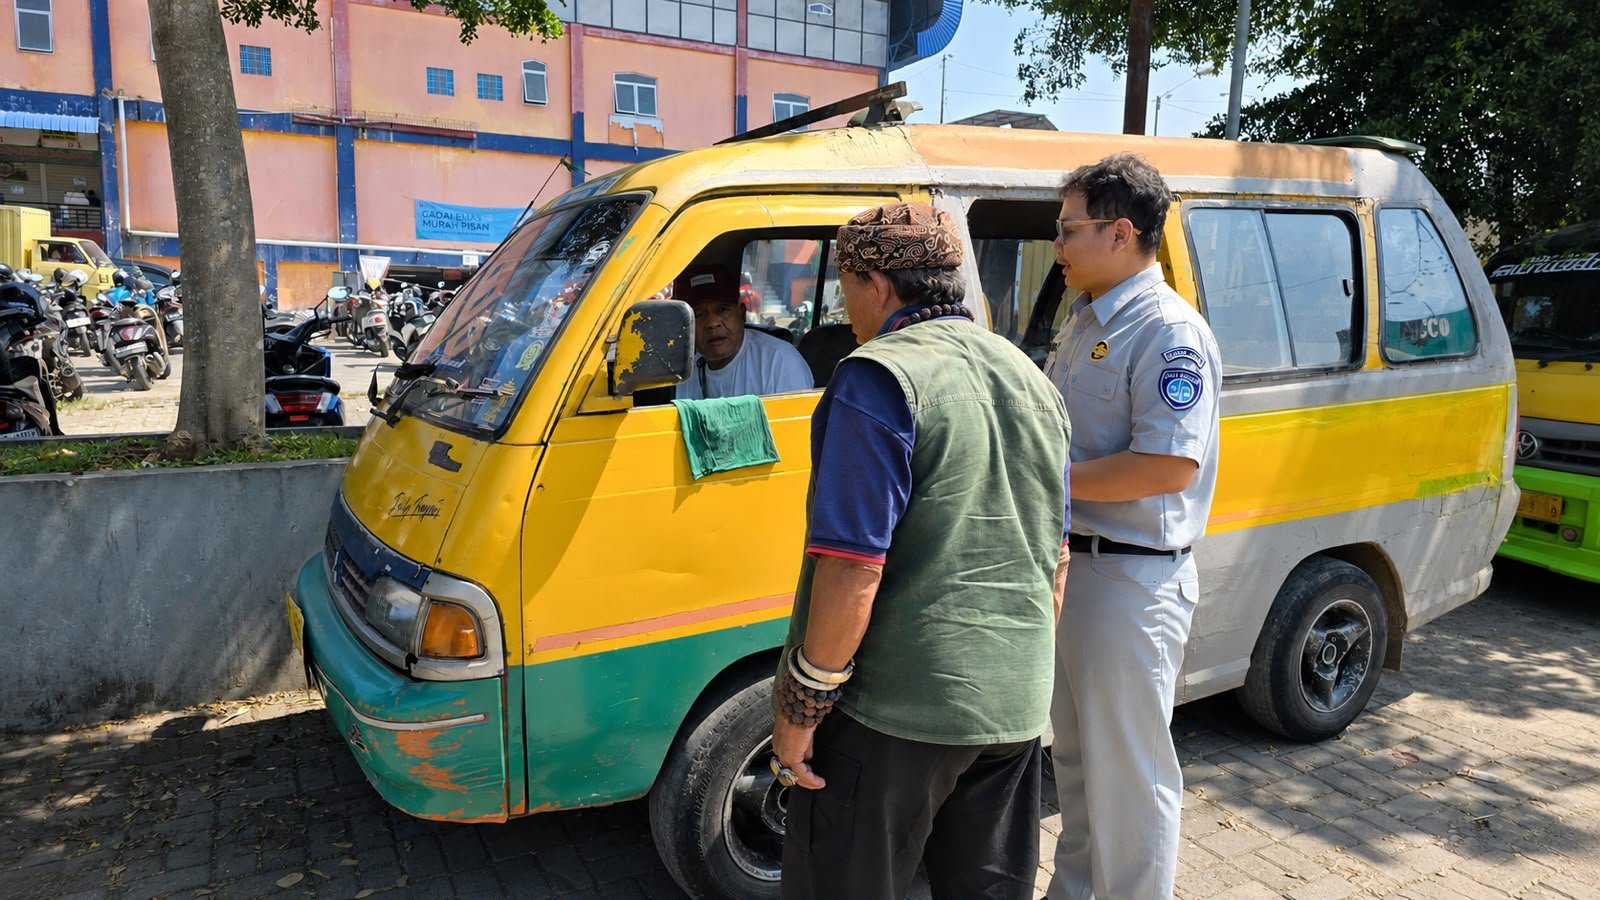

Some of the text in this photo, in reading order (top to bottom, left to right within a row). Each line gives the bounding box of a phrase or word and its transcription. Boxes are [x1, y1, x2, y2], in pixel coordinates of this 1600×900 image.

[421, 210, 453, 220] GADAI
[422, 220, 490, 231] MURAH PISAN
